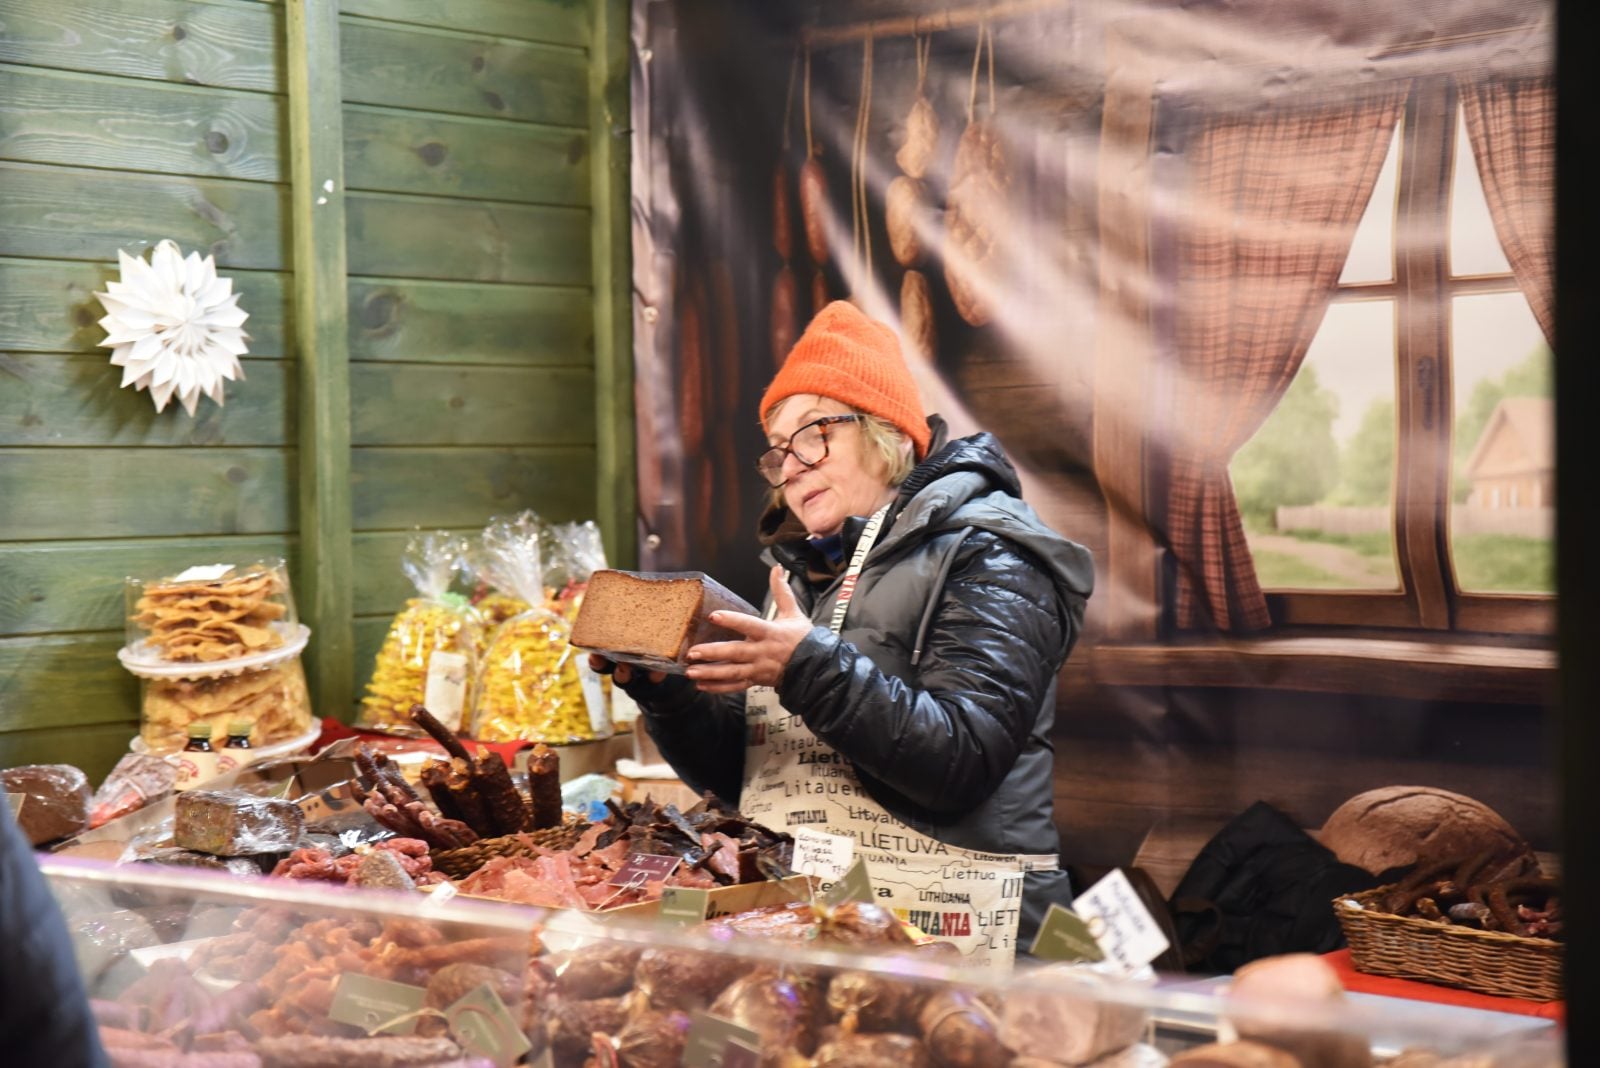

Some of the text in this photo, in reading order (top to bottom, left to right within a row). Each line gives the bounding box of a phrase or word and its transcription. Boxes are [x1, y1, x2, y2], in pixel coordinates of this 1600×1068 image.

[785, 780, 865, 797] Litauen
[849, 806, 906, 829] Litvan
[860, 831, 950, 857] LIETUVA
[943, 868, 996, 880] Liettua
[919, 891, 971, 904] LITHUANIA
